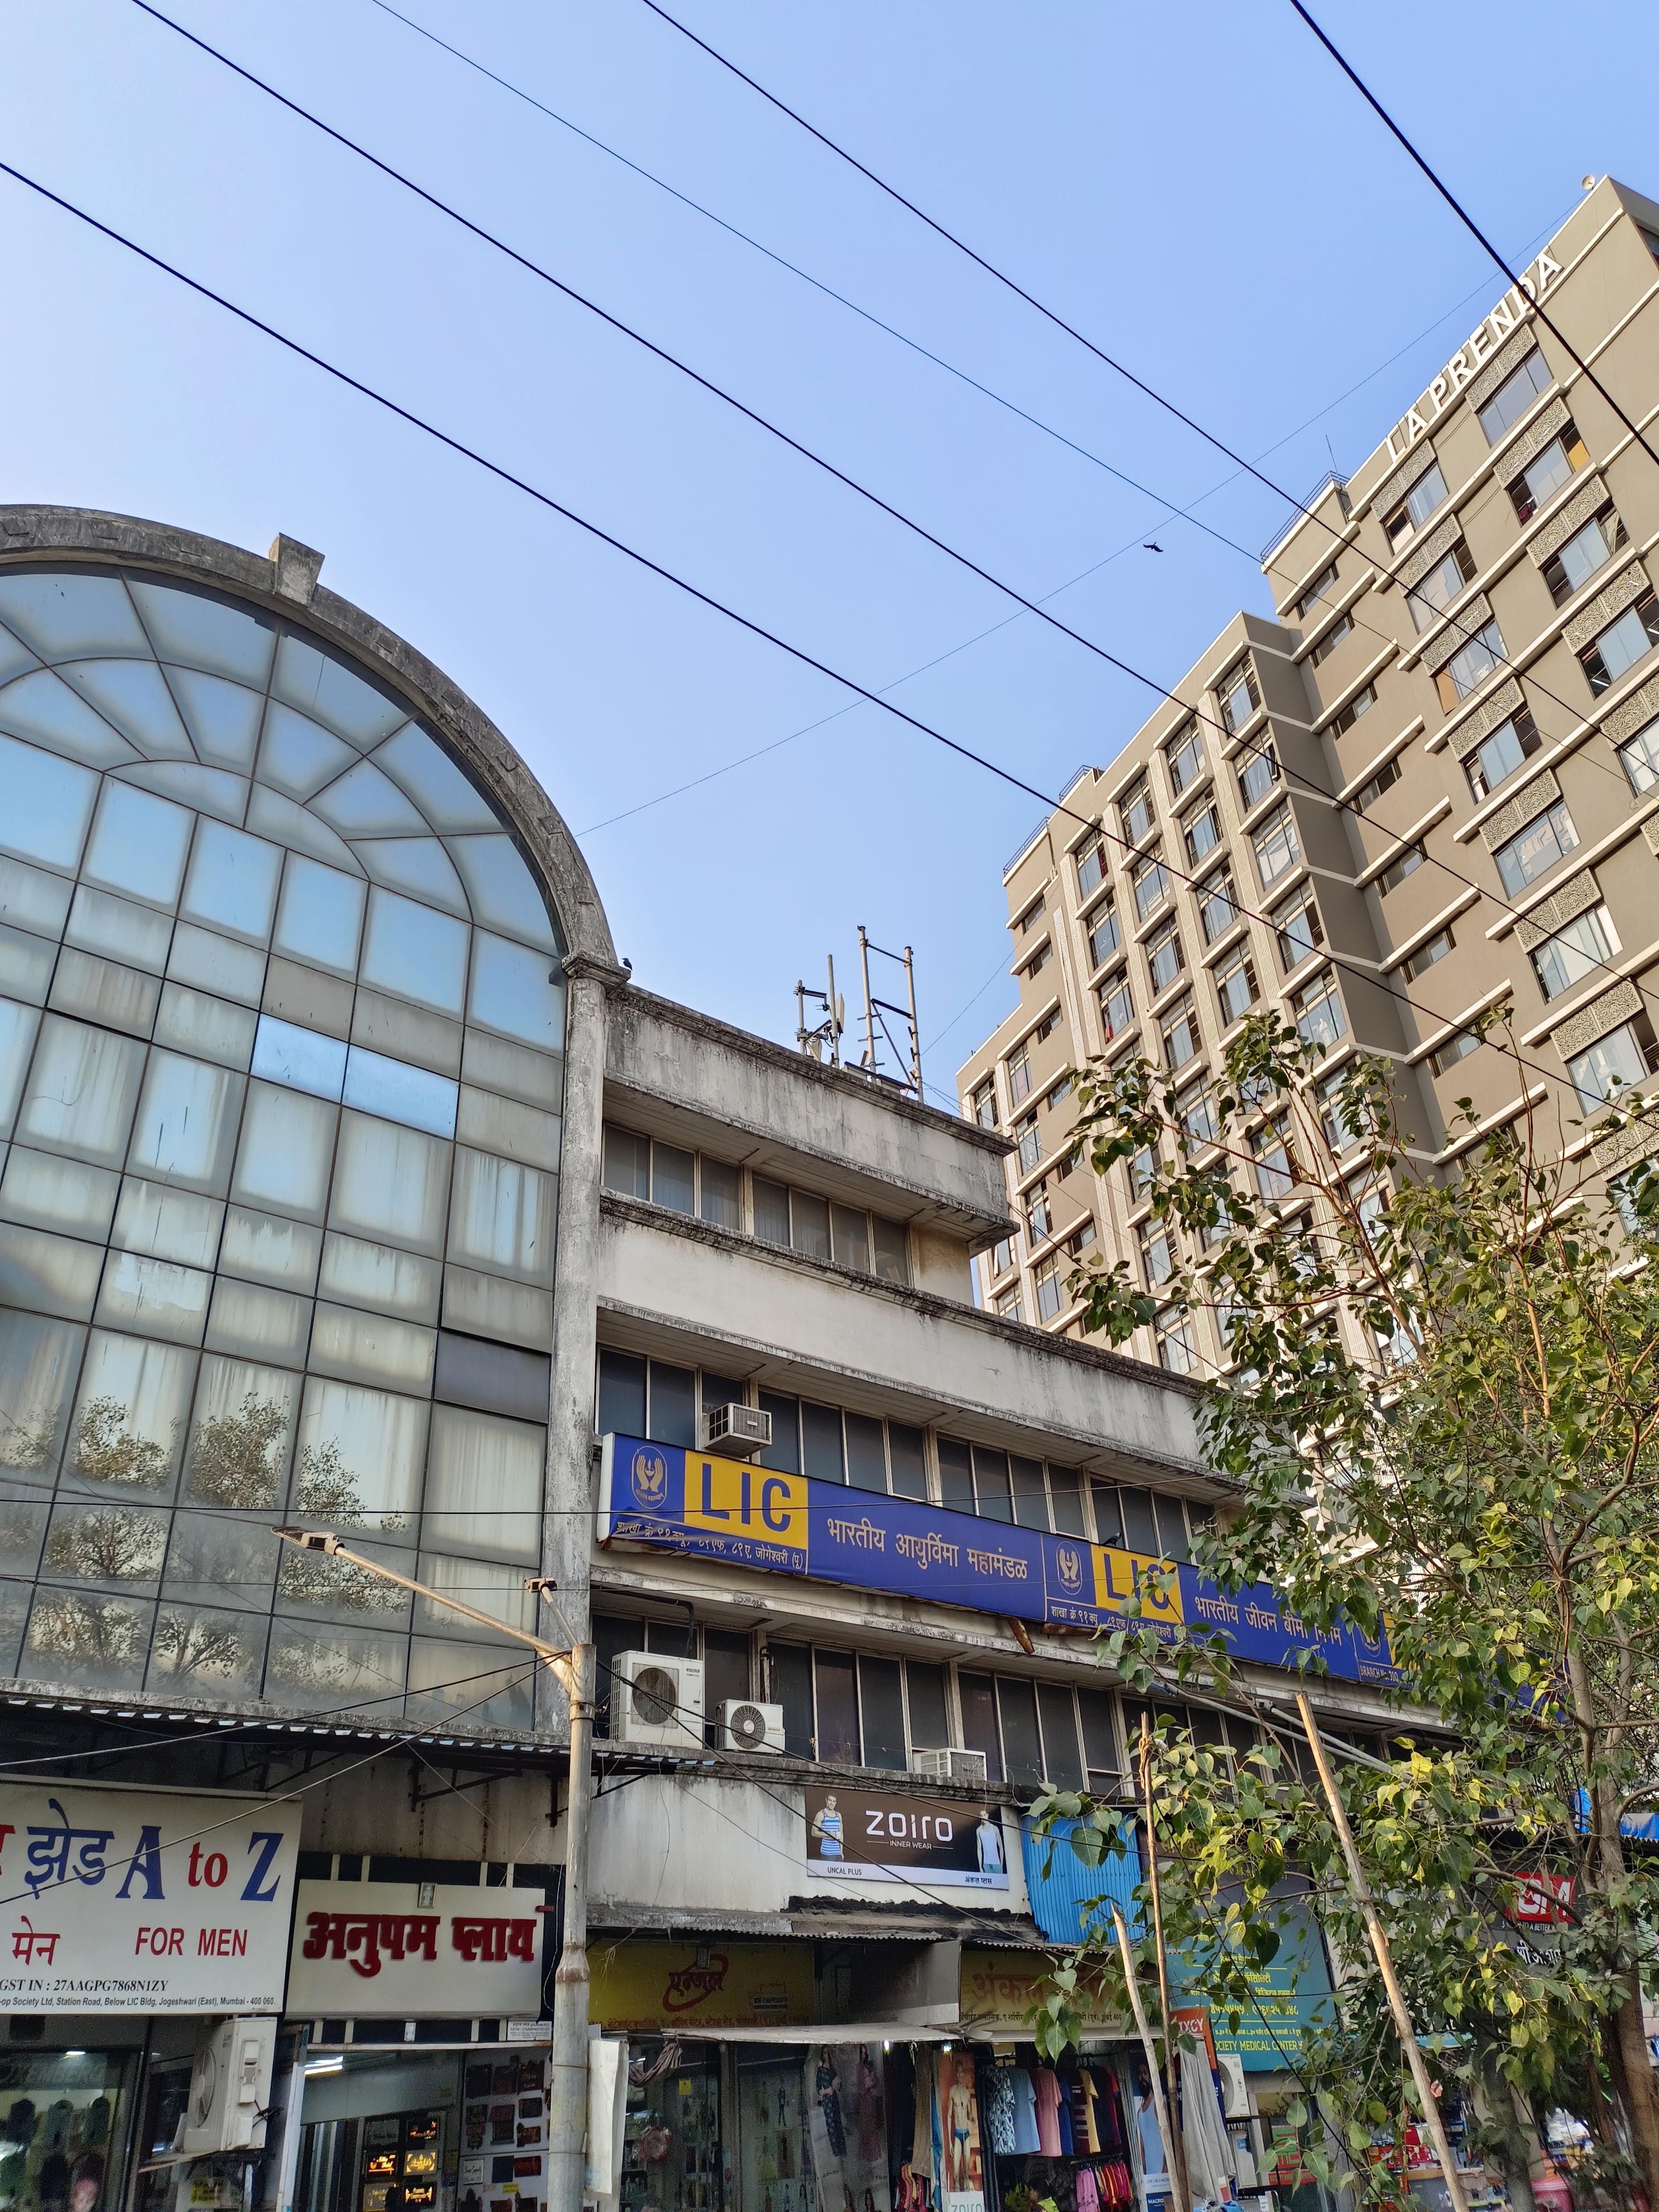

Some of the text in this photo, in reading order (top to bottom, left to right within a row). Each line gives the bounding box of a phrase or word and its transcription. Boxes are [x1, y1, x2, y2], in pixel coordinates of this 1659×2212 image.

[1386, 250, 1564, 464] LA PRENDA
[702, 1463, 792, 1532] LIC
[827, 1517, 886, 1552] भारतीय
[967, 1547, 1028, 1579] महामंडळ
[1195, 1595, 1238, 1625] भारतीय
[1244, 1601, 1278, 1633] जीवन
[1359, 1665, 1380, 1678] BRANCH
[890, 1839, 932, 1850] INNER WEAR
[115, 1826, 284, 1902] A to Z
[827, 1866, 862, 1876] UNCAL PLUS
[964, 1876, 992, 1885] अंकल प्लस
[12, 1915, 60, 1966] मेन
[135, 1927, 248, 1956] FOR MEN
[303, 1912, 537, 1978] अनुपम प्लाय
[0, 1979, 25, 1991] GST
[29, 1980, 44, 1991] IN
[13, 1997, 39, 2008] Society
[41, 1997, 54, 2007] Ltd,
[57, 1997, 81, 2006] Station
[83, 1997, 102, 2007] Road,
[105, 1997, 126, 2006] Below
[127, 1997, 139, 2006] LIC
[140, 1997, 157, 2008] Bldg,
[159, 1997, 197, 2008] Jogeshwari
[198, 1997, 219, 2008] (East),
[220, 1997, 246, 2006] Mumbai
[250, 1996, 262, 2005] 400
[1239, 2041, 1271, 2051] MEDICAL
